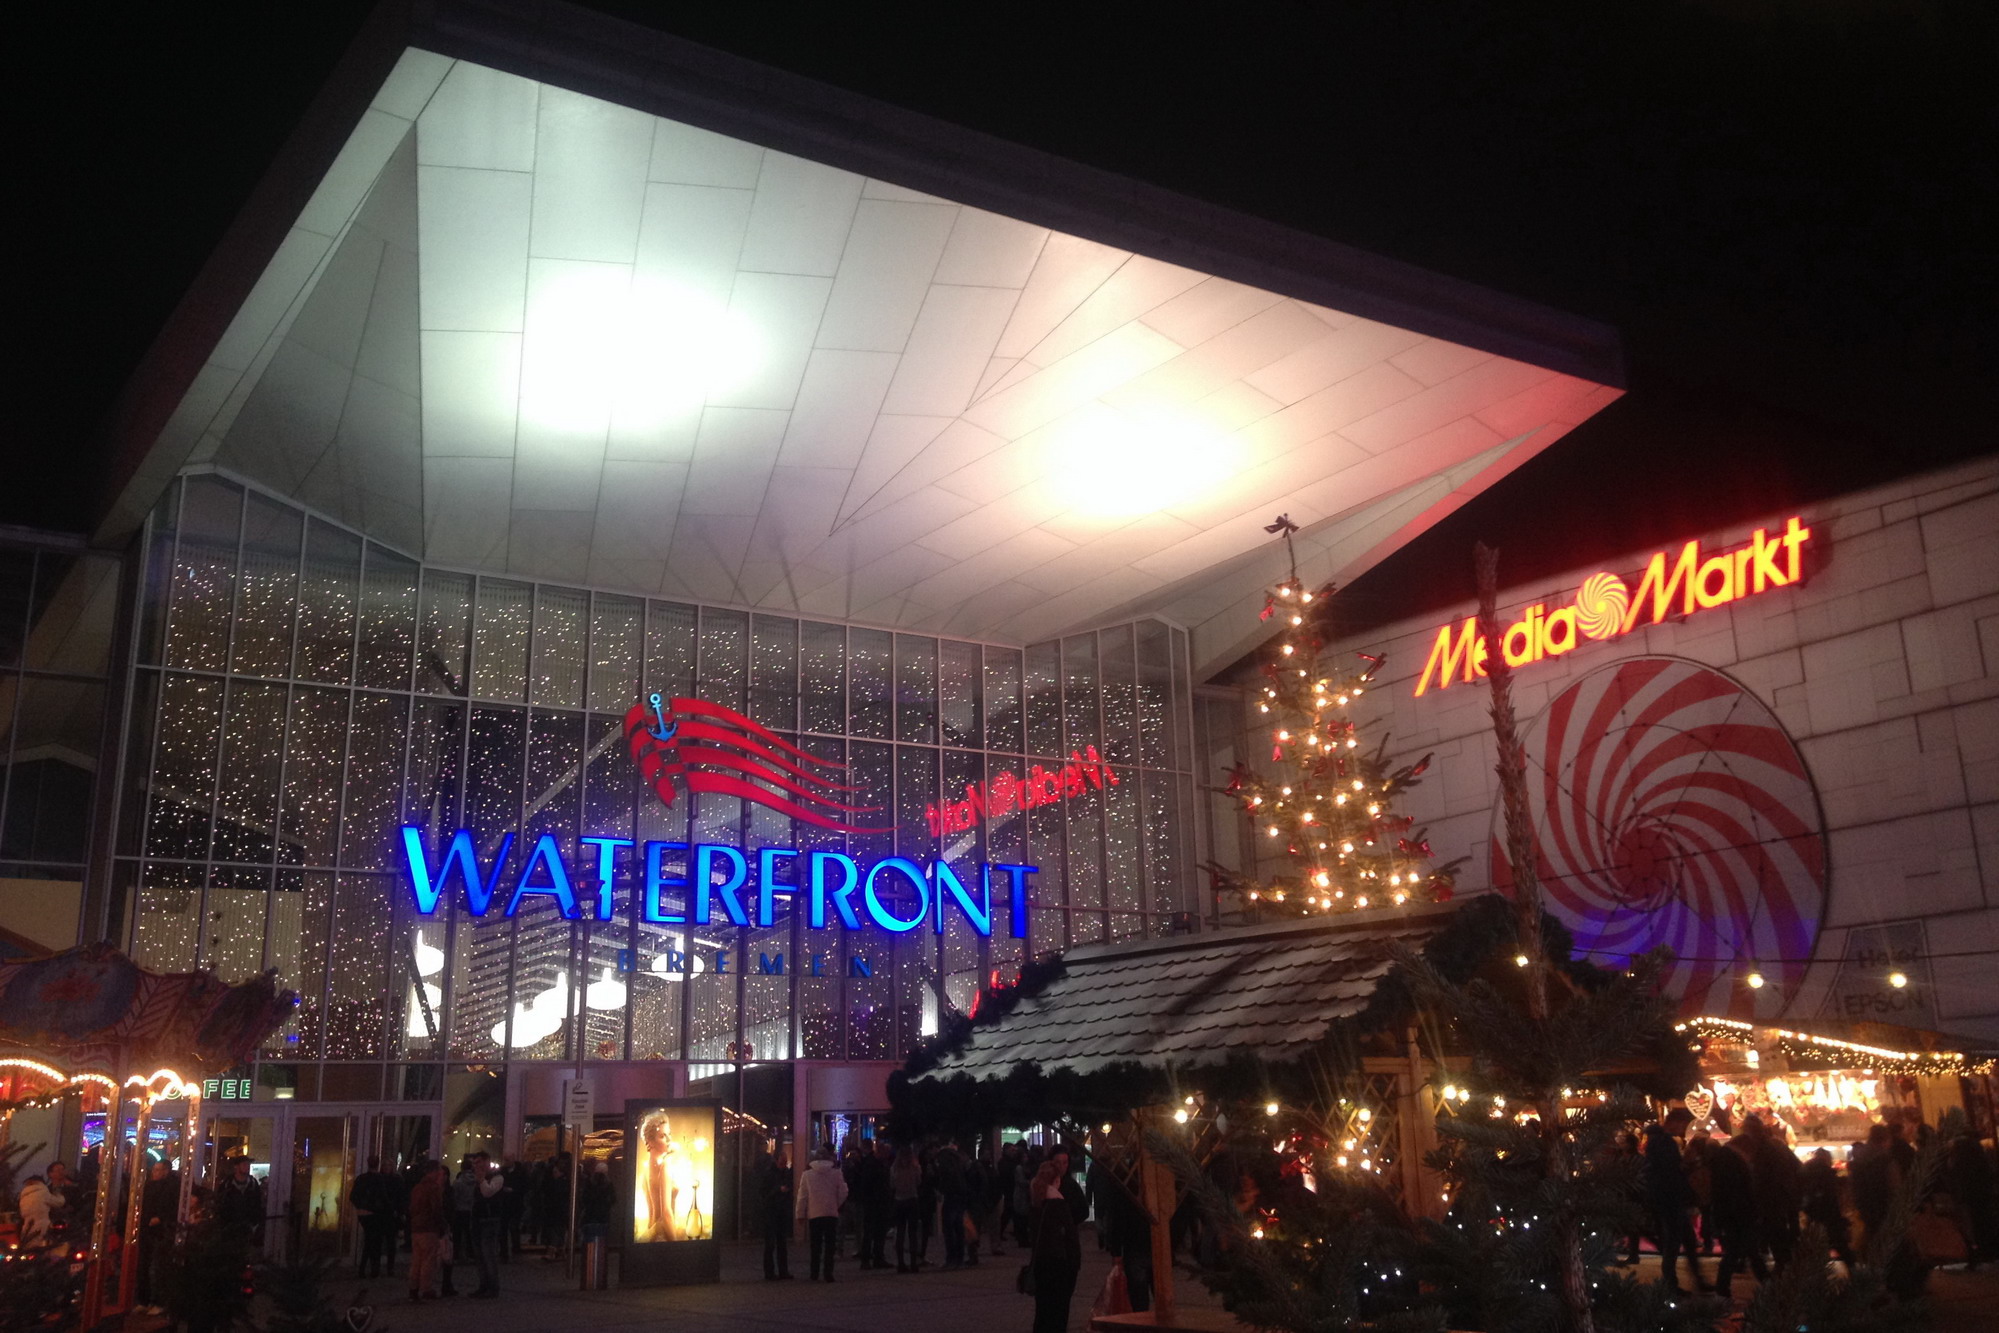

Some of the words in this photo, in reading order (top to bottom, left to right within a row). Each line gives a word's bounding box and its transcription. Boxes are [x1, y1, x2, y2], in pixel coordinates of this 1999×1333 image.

[1621, 516, 1812, 634] Markt
[401, 826, 1040, 938] WATERFRONT
[617, 949, 872, 978] BREMEN
[1844, 989, 1925, 1015] EPSON
